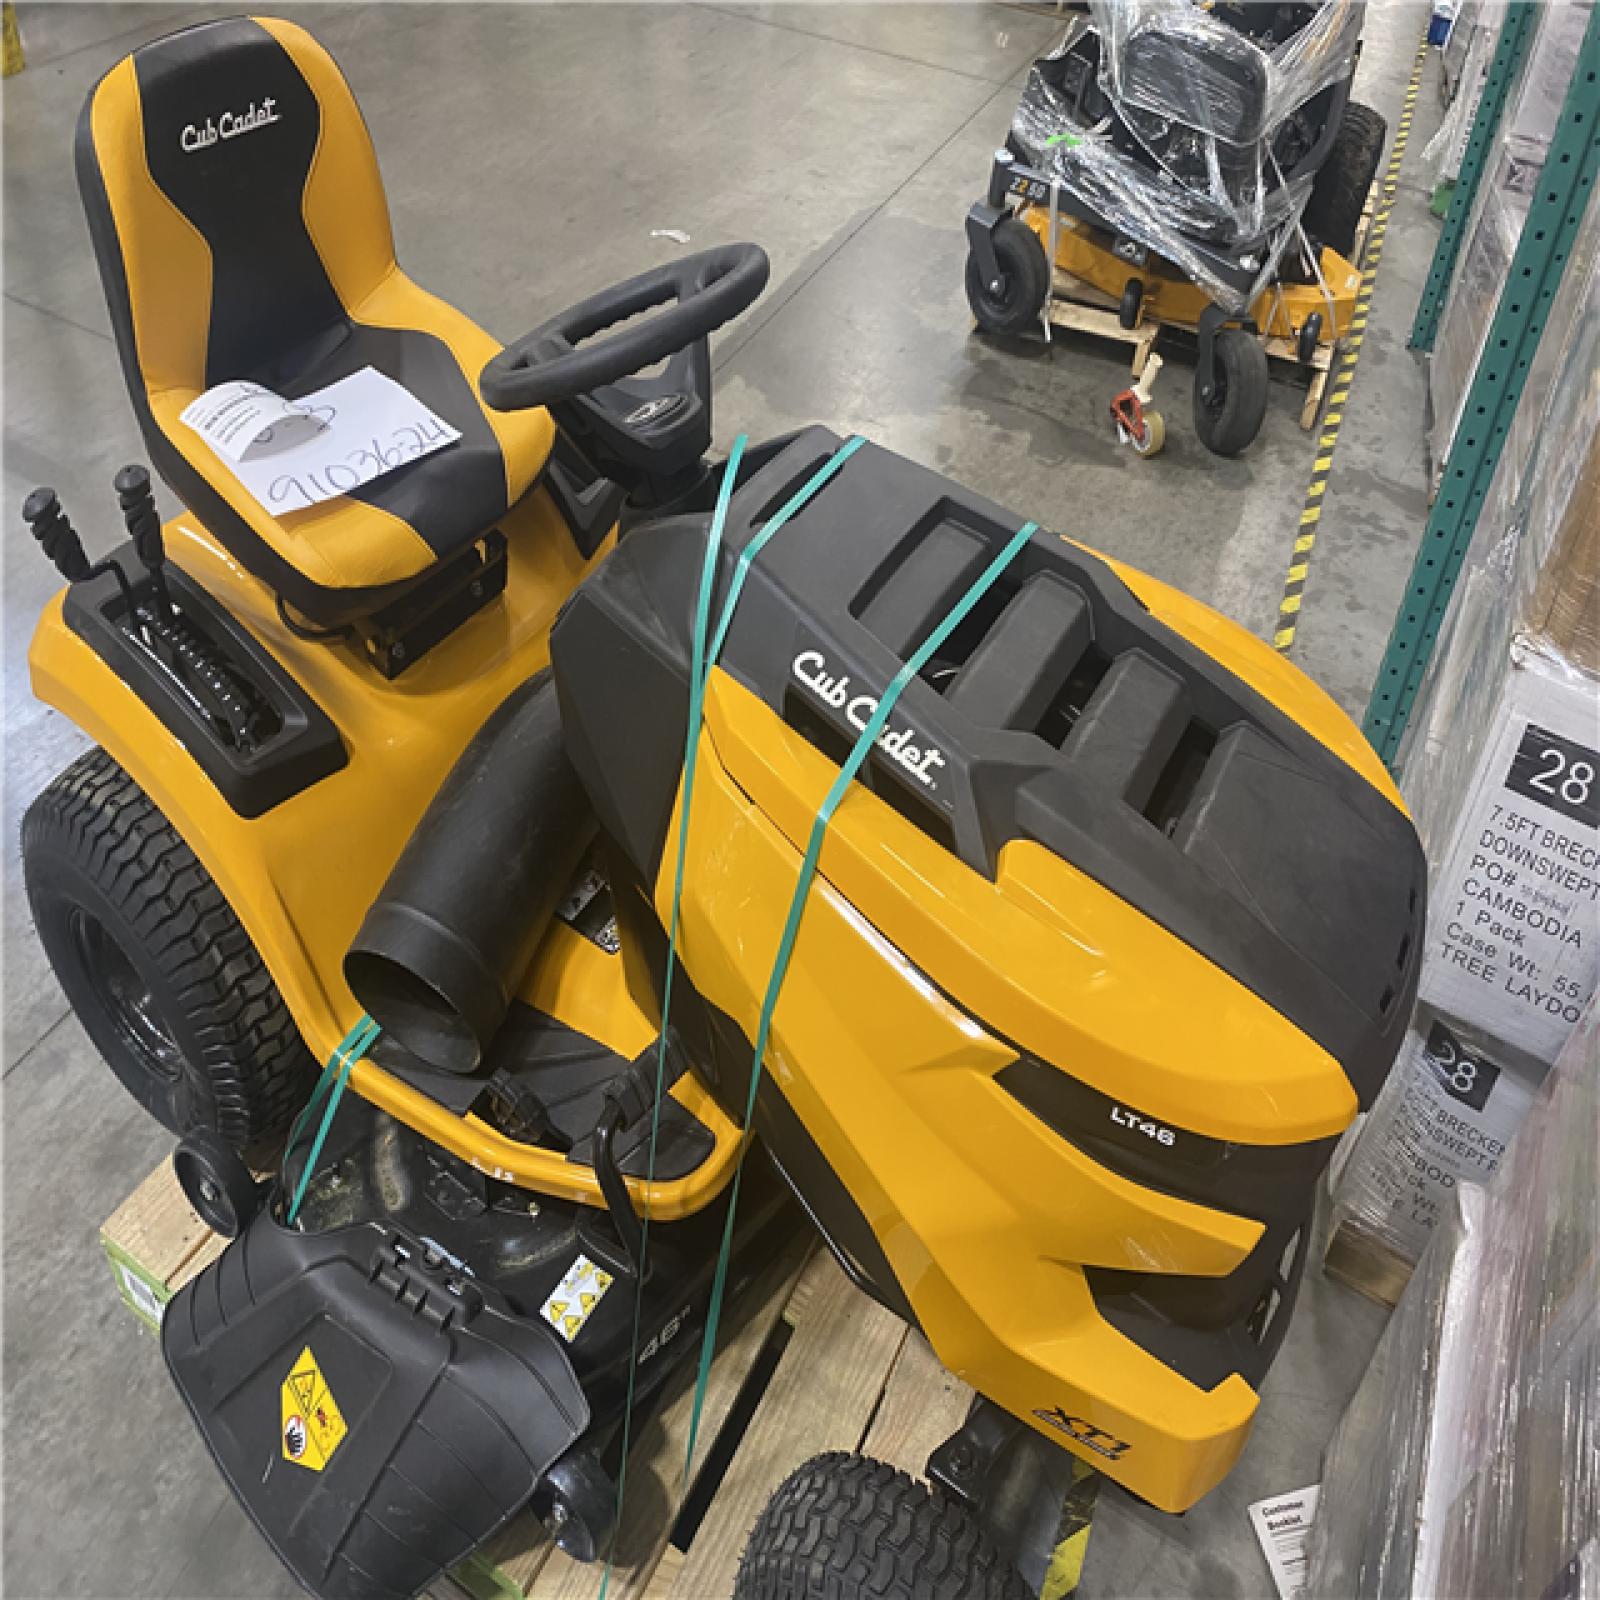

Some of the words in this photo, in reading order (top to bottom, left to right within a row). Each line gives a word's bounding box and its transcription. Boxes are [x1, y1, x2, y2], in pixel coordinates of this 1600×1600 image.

[181, 124, 218, 152] Cub
[219, 96, 280, 138] Cadet
[793, 651, 849, 707] Cub
[846, 695, 945, 784] Cdet
[1529, 748, 1596, 805] 28
[1489, 804, 1542, 841] 7.5FT
[1470, 854, 1518, 888] PO#
[1463, 878, 1581, 948] CAMBODIA
[1474, 909, 1527, 949] Pack
[1446, 921, 1498, 958] Case
[1442, 941, 1498, 984] TREE
[1109, 1106, 1176, 1146] LT46
